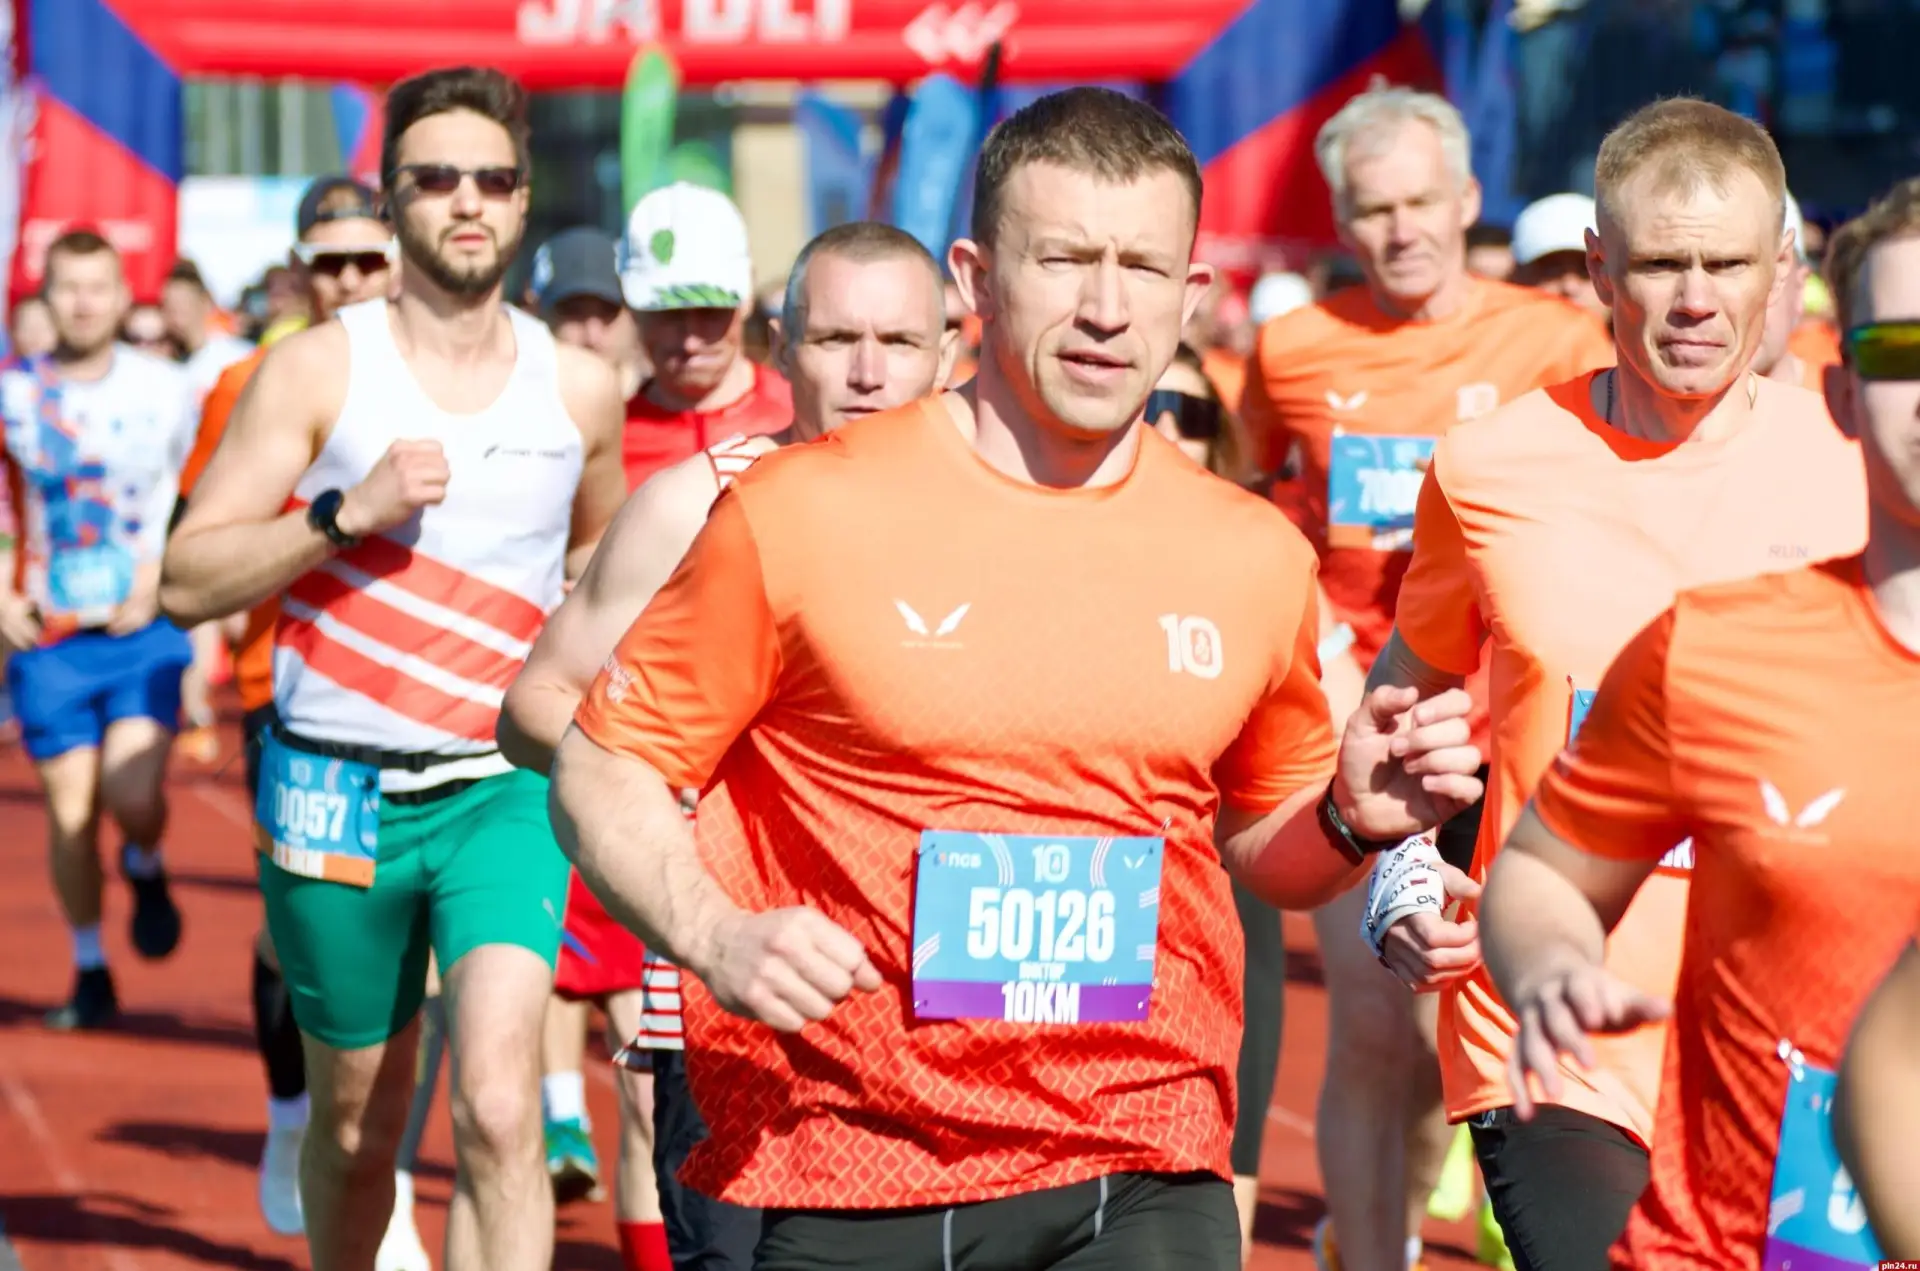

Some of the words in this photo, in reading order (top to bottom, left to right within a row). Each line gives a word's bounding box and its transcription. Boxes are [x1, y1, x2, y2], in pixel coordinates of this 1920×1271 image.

[1767, 544, 1808, 559] RUN
[1157, 612, 1223, 679] 10
[1032, 844, 1070, 883] 10
[967, 887, 1116, 963] 50126
